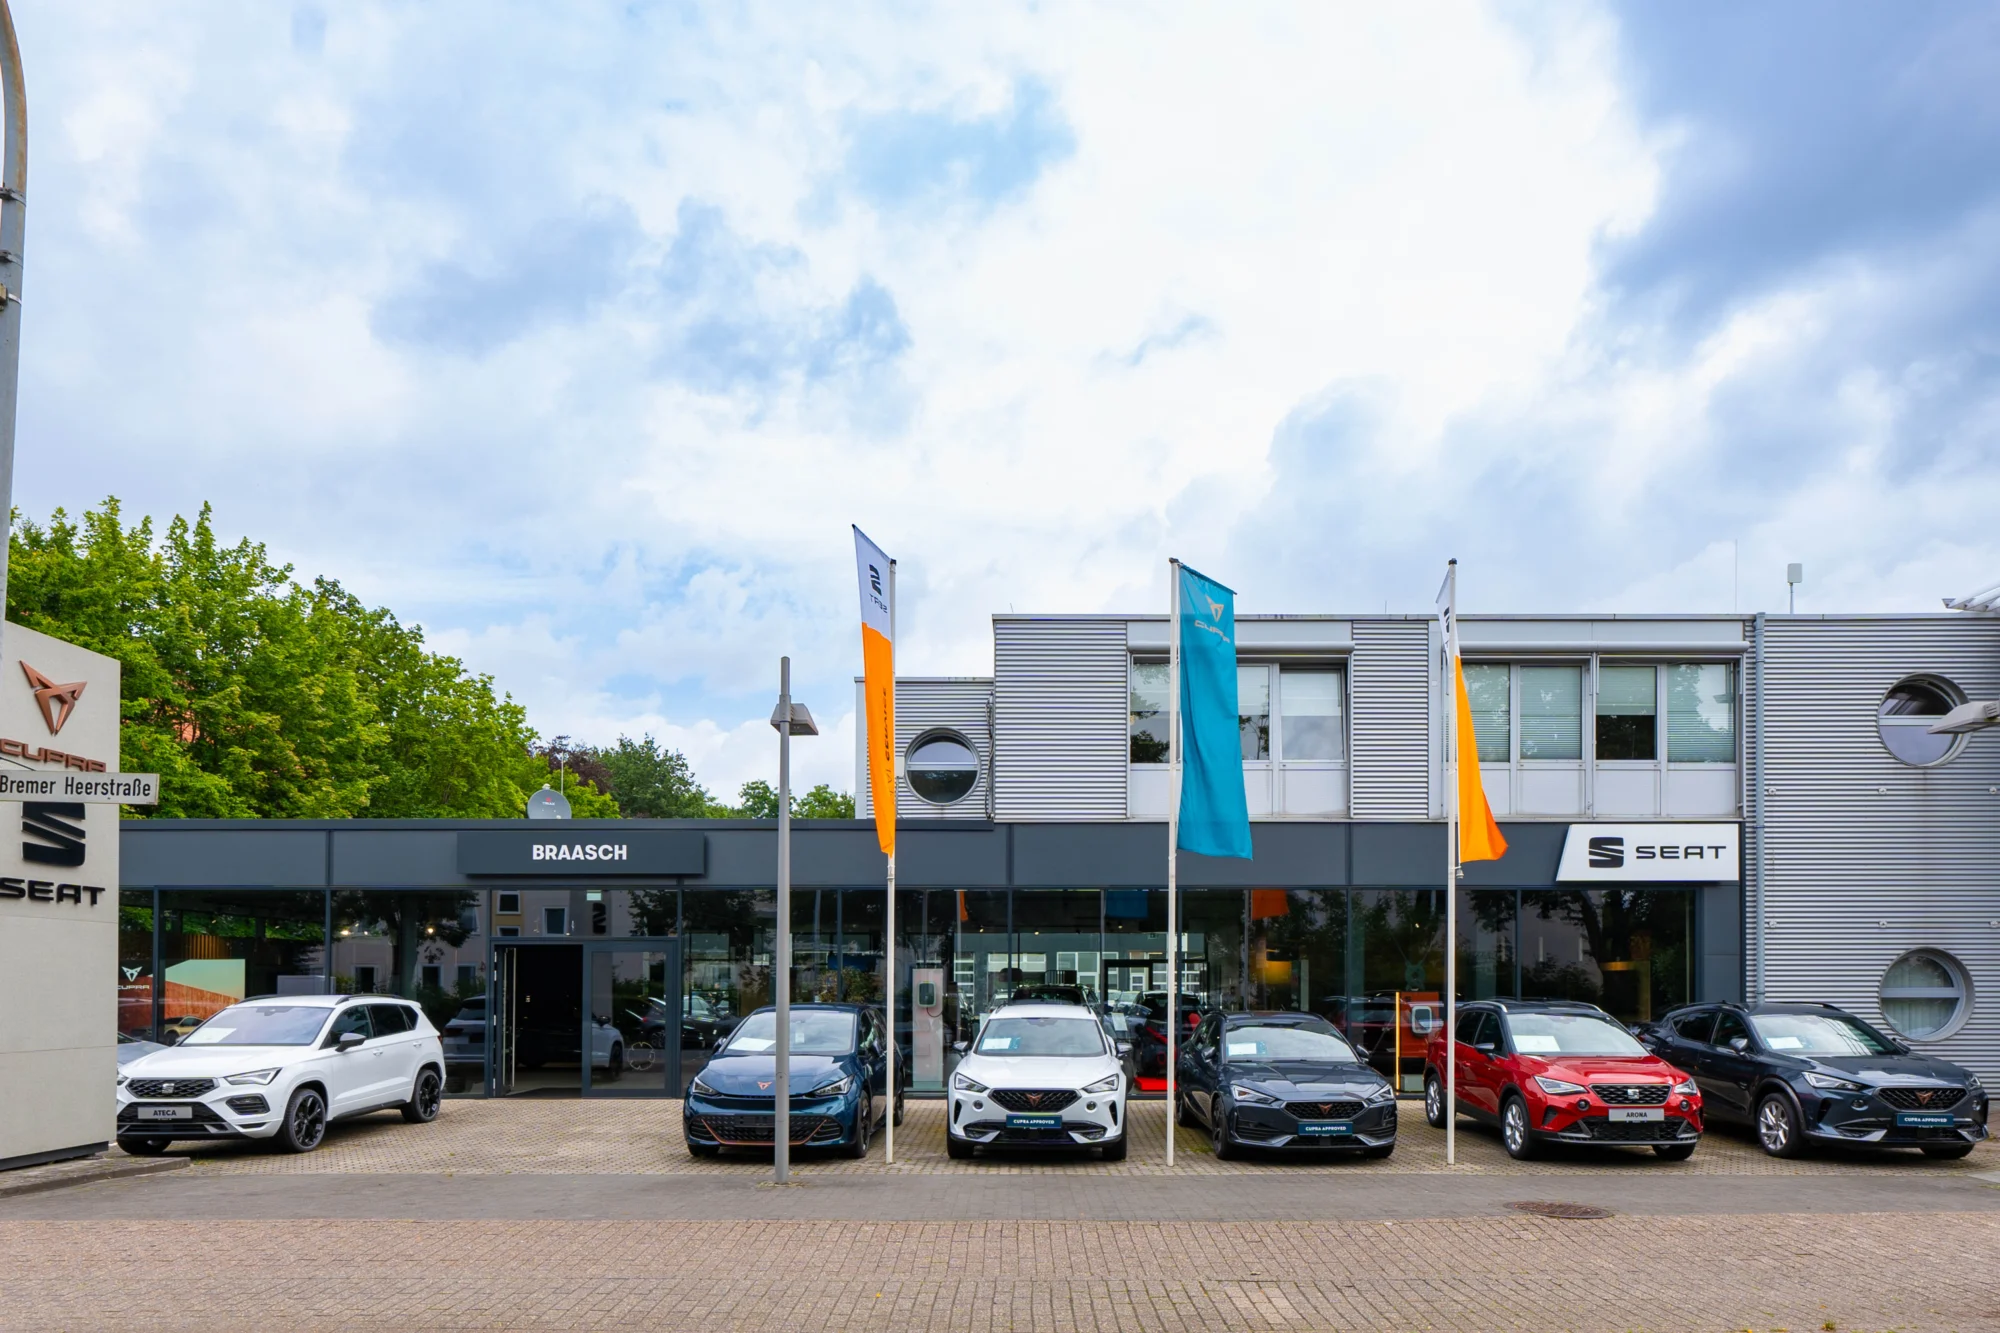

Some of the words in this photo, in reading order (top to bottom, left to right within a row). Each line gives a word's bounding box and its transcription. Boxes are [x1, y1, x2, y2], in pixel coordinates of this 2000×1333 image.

[0, 738, 107, 773] CUPRA
[0, 774, 56, 795] Bremer
[64, 776, 151, 797] Heerstraße
[532, 844, 628, 861] BRAASCH
[1635, 845, 1727, 860] SEAT
[0, 877, 106, 907] SEAT
[153, 1109, 177, 1117] ATECA
